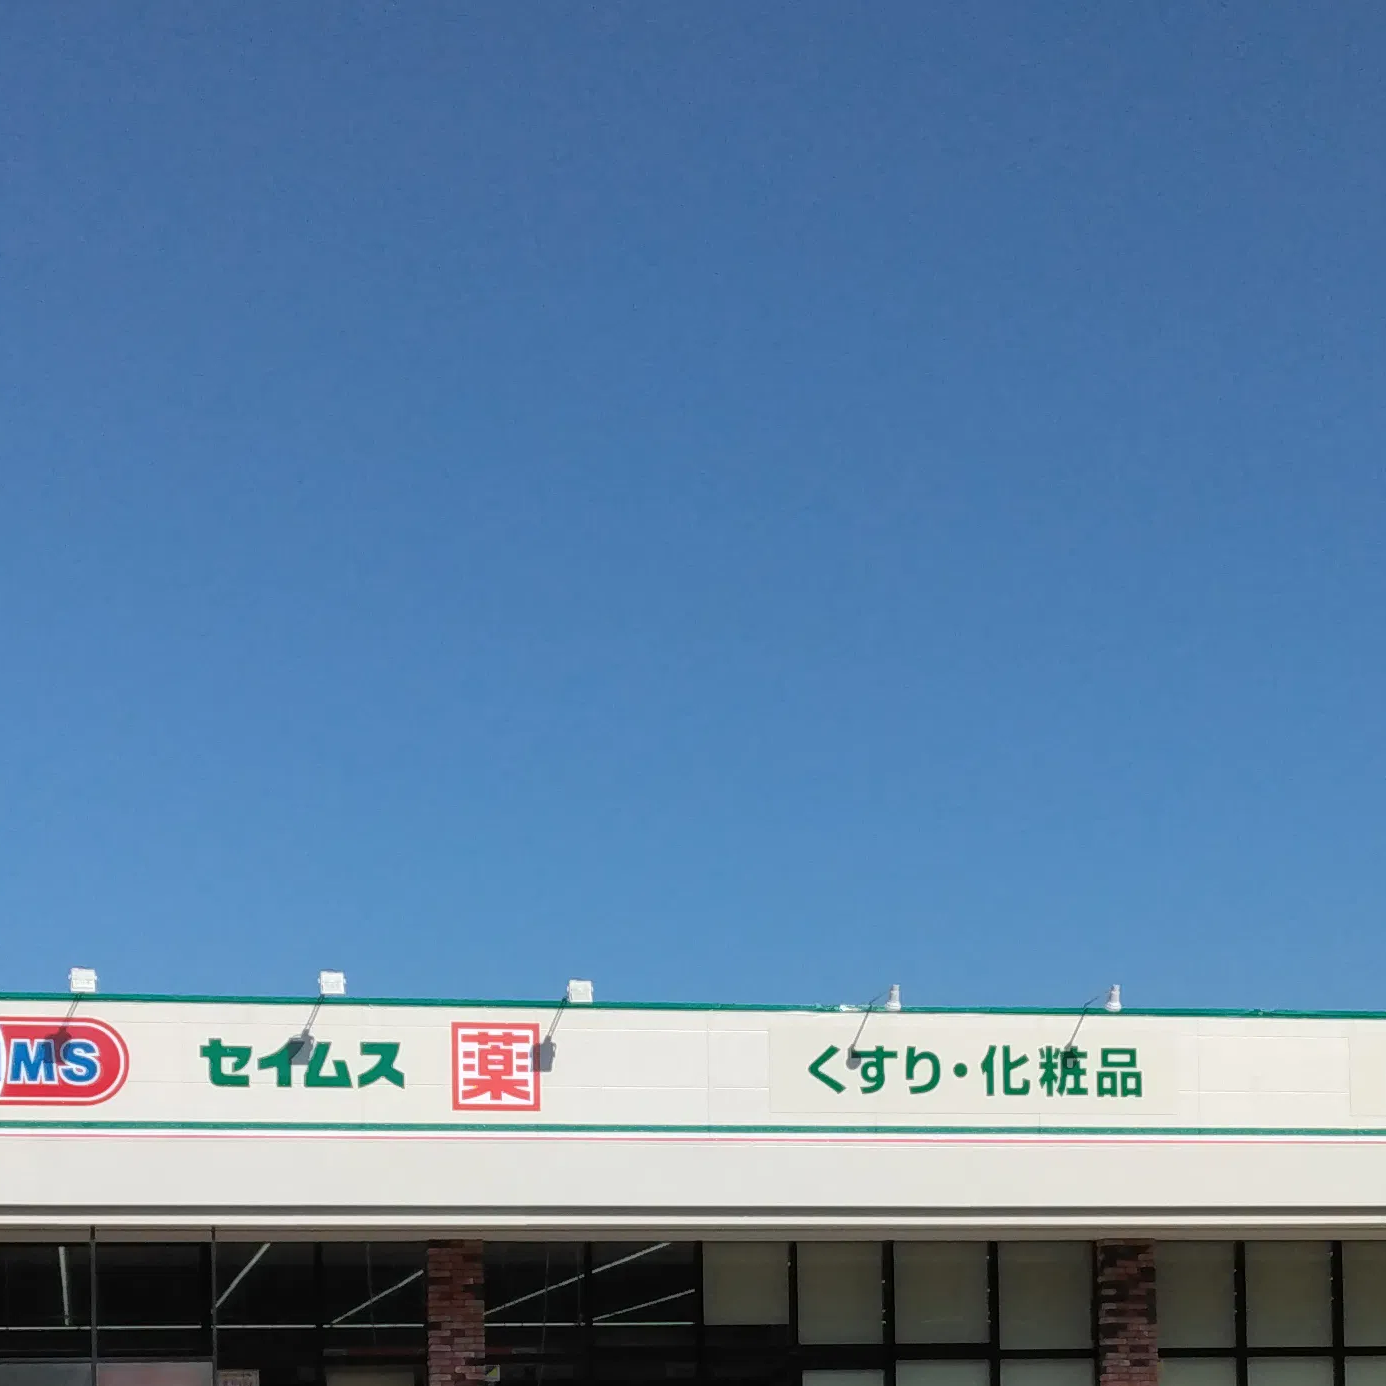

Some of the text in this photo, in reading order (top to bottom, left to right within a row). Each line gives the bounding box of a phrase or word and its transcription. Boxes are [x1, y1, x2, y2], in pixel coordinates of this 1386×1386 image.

[200, 1038, 405, 1088] セイムス
[461, 1031, 531, 1101] 薬
[808, 1045, 1143, 1098] くすり・化粧品
